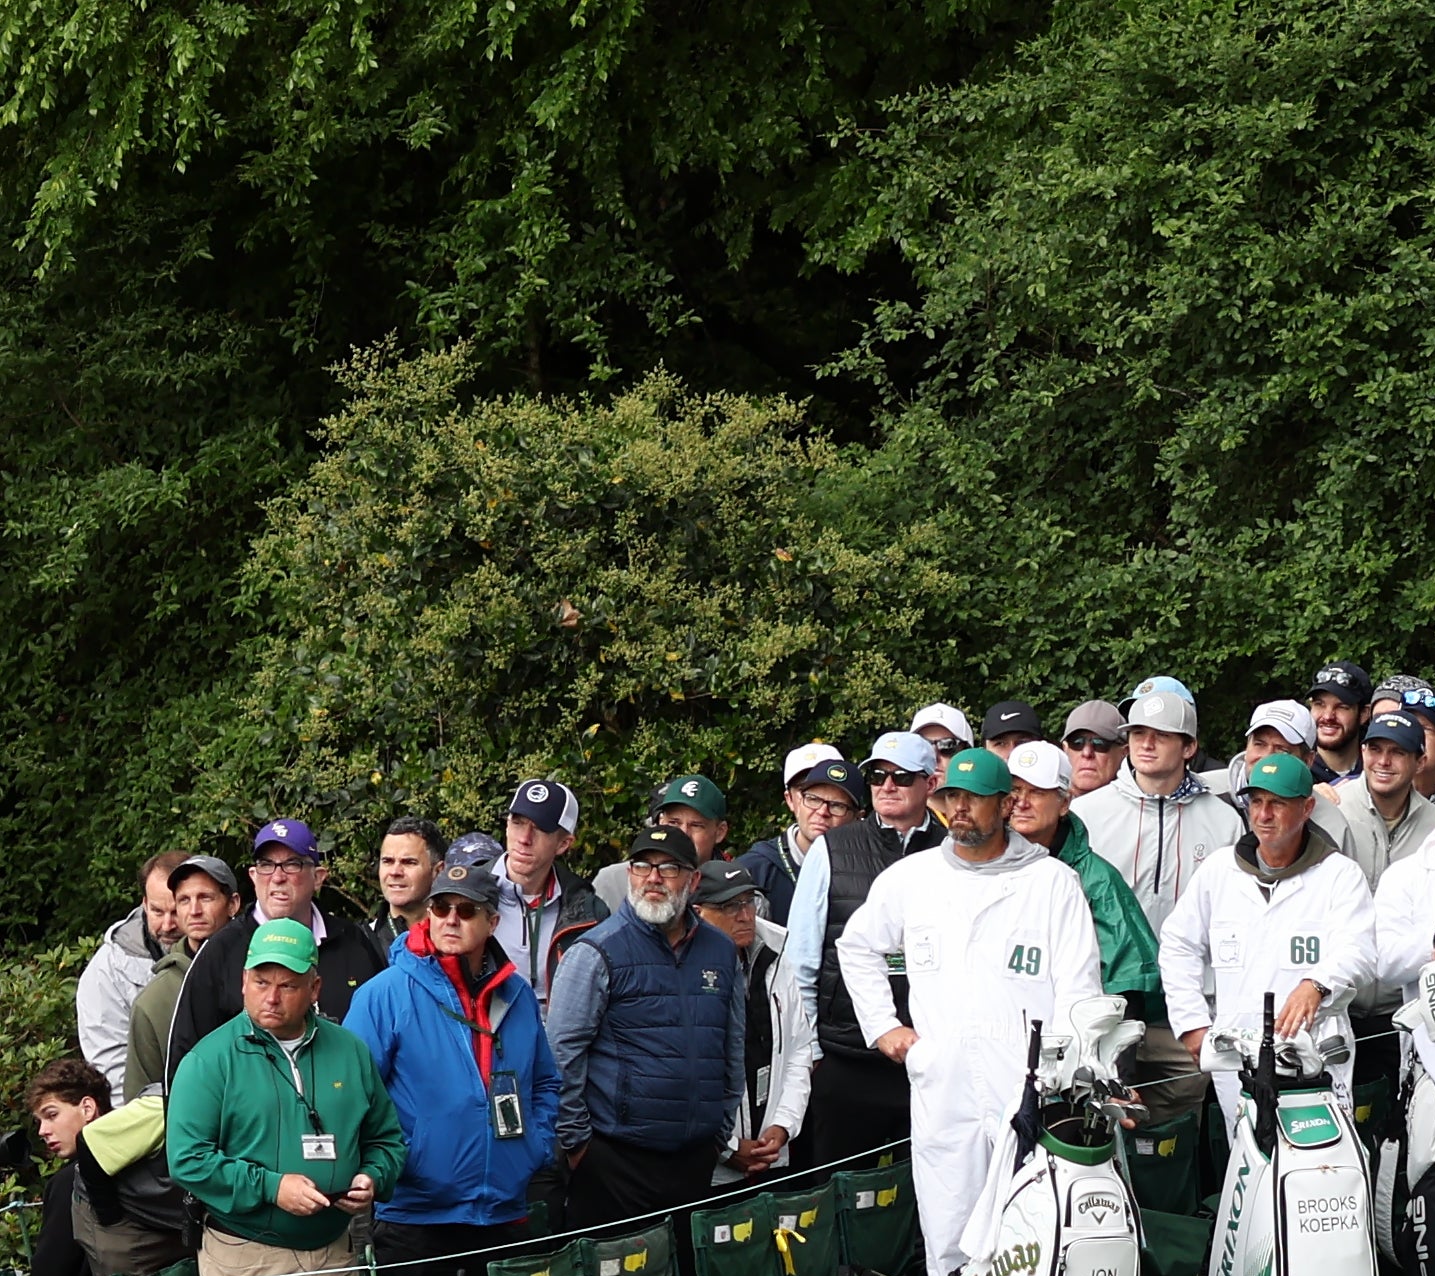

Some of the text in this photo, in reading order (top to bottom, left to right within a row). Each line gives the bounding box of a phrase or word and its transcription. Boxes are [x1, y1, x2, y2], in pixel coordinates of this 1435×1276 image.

[1008, 944, 1042, 976] 49
[1290, 936, 1320, 965] 69
[1290, 1118, 1331, 1133] SRIXON
[1078, 1195, 1121, 1214] Callaway
[1298, 1195, 1358, 1214] BROOKS
[1299, 1215, 1359, 1233] KOEPKA
